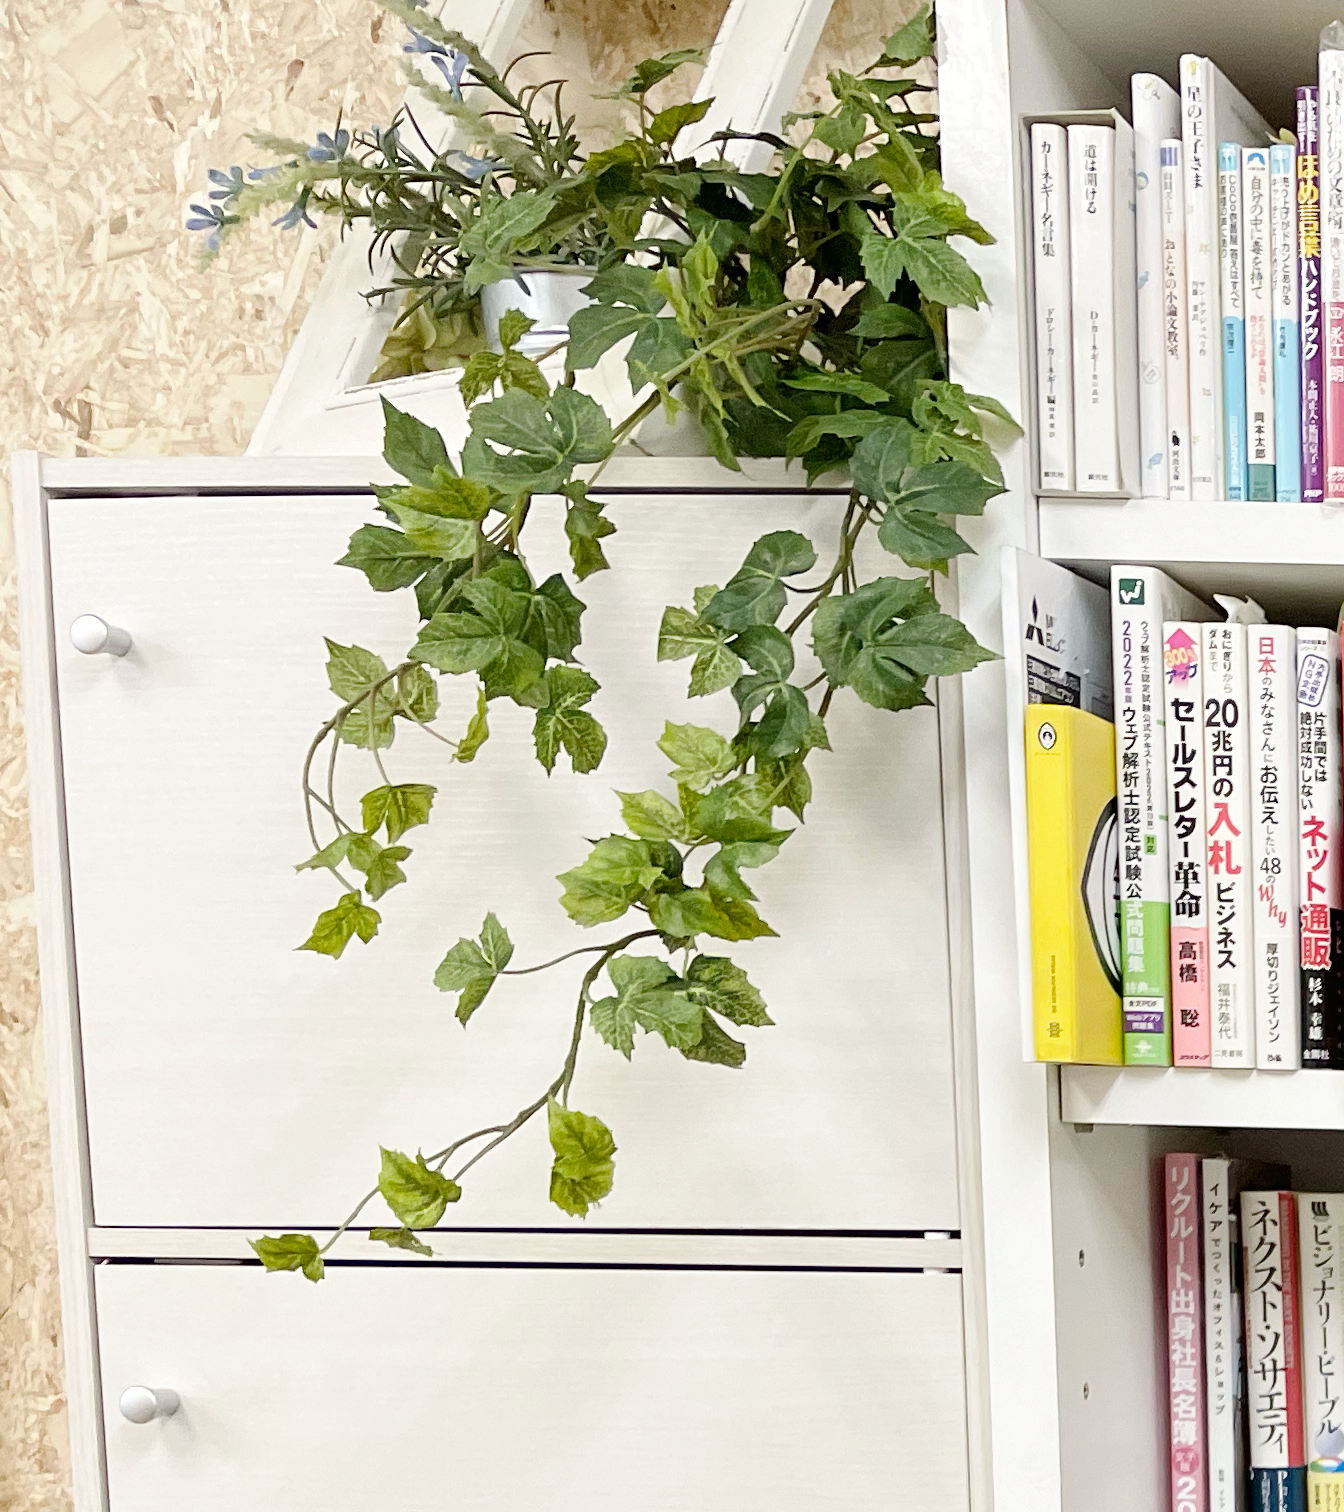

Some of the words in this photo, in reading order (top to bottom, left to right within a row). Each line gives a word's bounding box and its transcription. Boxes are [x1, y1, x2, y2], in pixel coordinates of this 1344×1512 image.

[1083, 143, 1099, 214] 道は開ける
[1186, 85, 1205, 189] 星の王子さま
[1040, 140, 1056, 258] カーネギー名言集
[1250, 175, 1264, 300] 自分の中に毒を持て
[1253, 411, 1266, 460] 岡本太郎
[1208, 628, 1220, 672] ダムまで
[1221, 628, 1234, 694] おにぎりから
[1257, 636, 1288, 928] 日本のみなさんにお伝えしたい48のWhy
[1299, 711, 1314, 810] 絶対成功しない
[1314, 711, 1328, 783] 片手間では
[1170, 697, 1202, 918] セールスレター革命
[1205, 698, 1242, 970] 20兆円の入札ビジネス
[1300, 815, 1333, 970] ネット通販
[1178, 941, 1198, 984] 高橋
[1217, 983, 1232, 1040] 福井泰代
[1265, 942, 1281, 1044] 厚切りジェイソン
[1169, 1165, 1198, 1449] リクルート出身社長名簿
[1248, 1199, 1288, 1456] ネクスト・ソサエティ
[1311, 1223, 1342, 1438] ビジョナリー・ピープル
